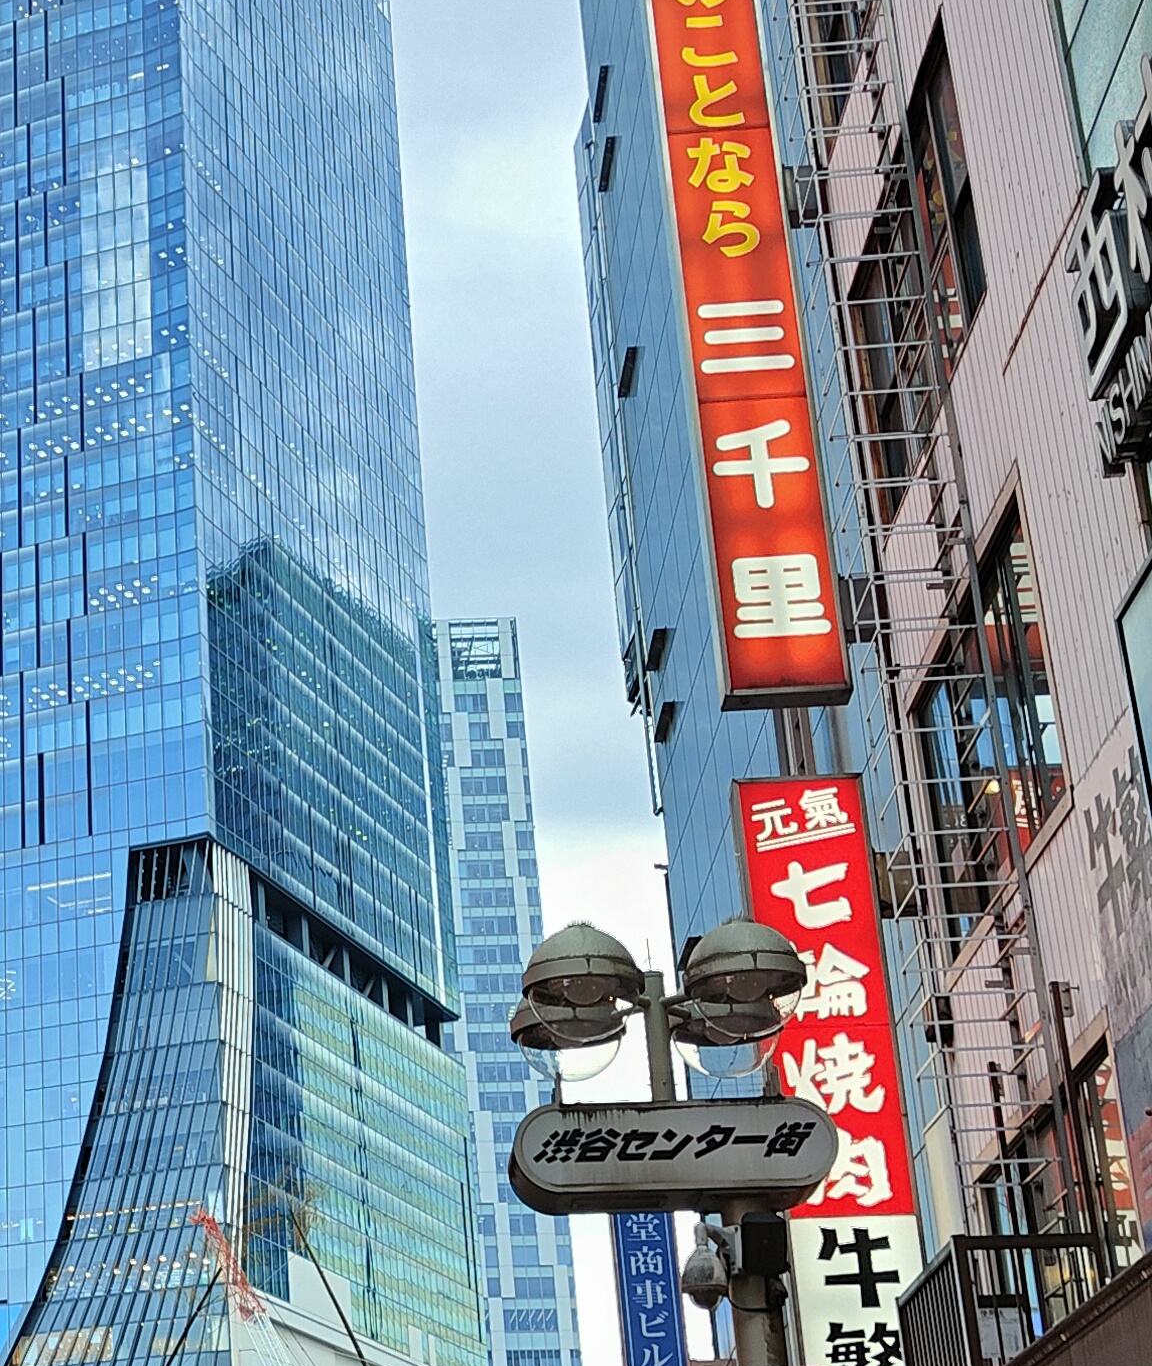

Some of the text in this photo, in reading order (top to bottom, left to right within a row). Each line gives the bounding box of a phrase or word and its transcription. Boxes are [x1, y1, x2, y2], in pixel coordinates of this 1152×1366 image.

[697, 299, 832, 640] 三千里
[533, 1122, 817, 1164] 渋谷センター街
